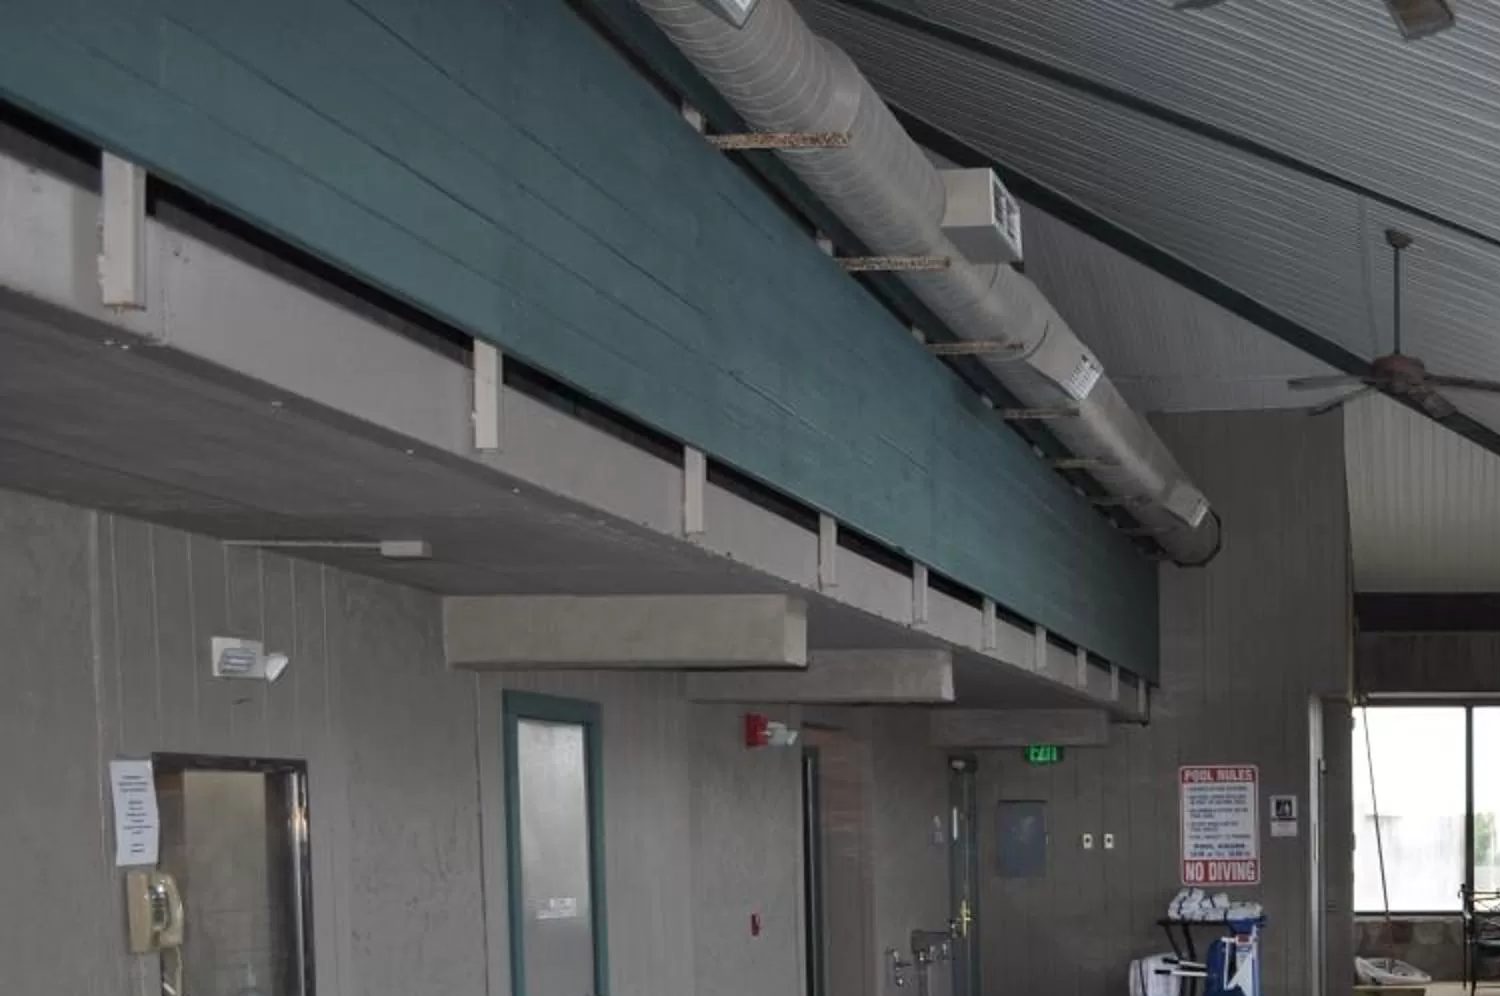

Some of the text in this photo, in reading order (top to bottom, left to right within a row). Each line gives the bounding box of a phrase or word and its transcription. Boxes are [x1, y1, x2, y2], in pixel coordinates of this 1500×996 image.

[1029, 747, 1057, 761] EXIT
[1184, 769, 1253, 782] POOL RULES
[1185, 862, 1256, 881] NO DIVING
